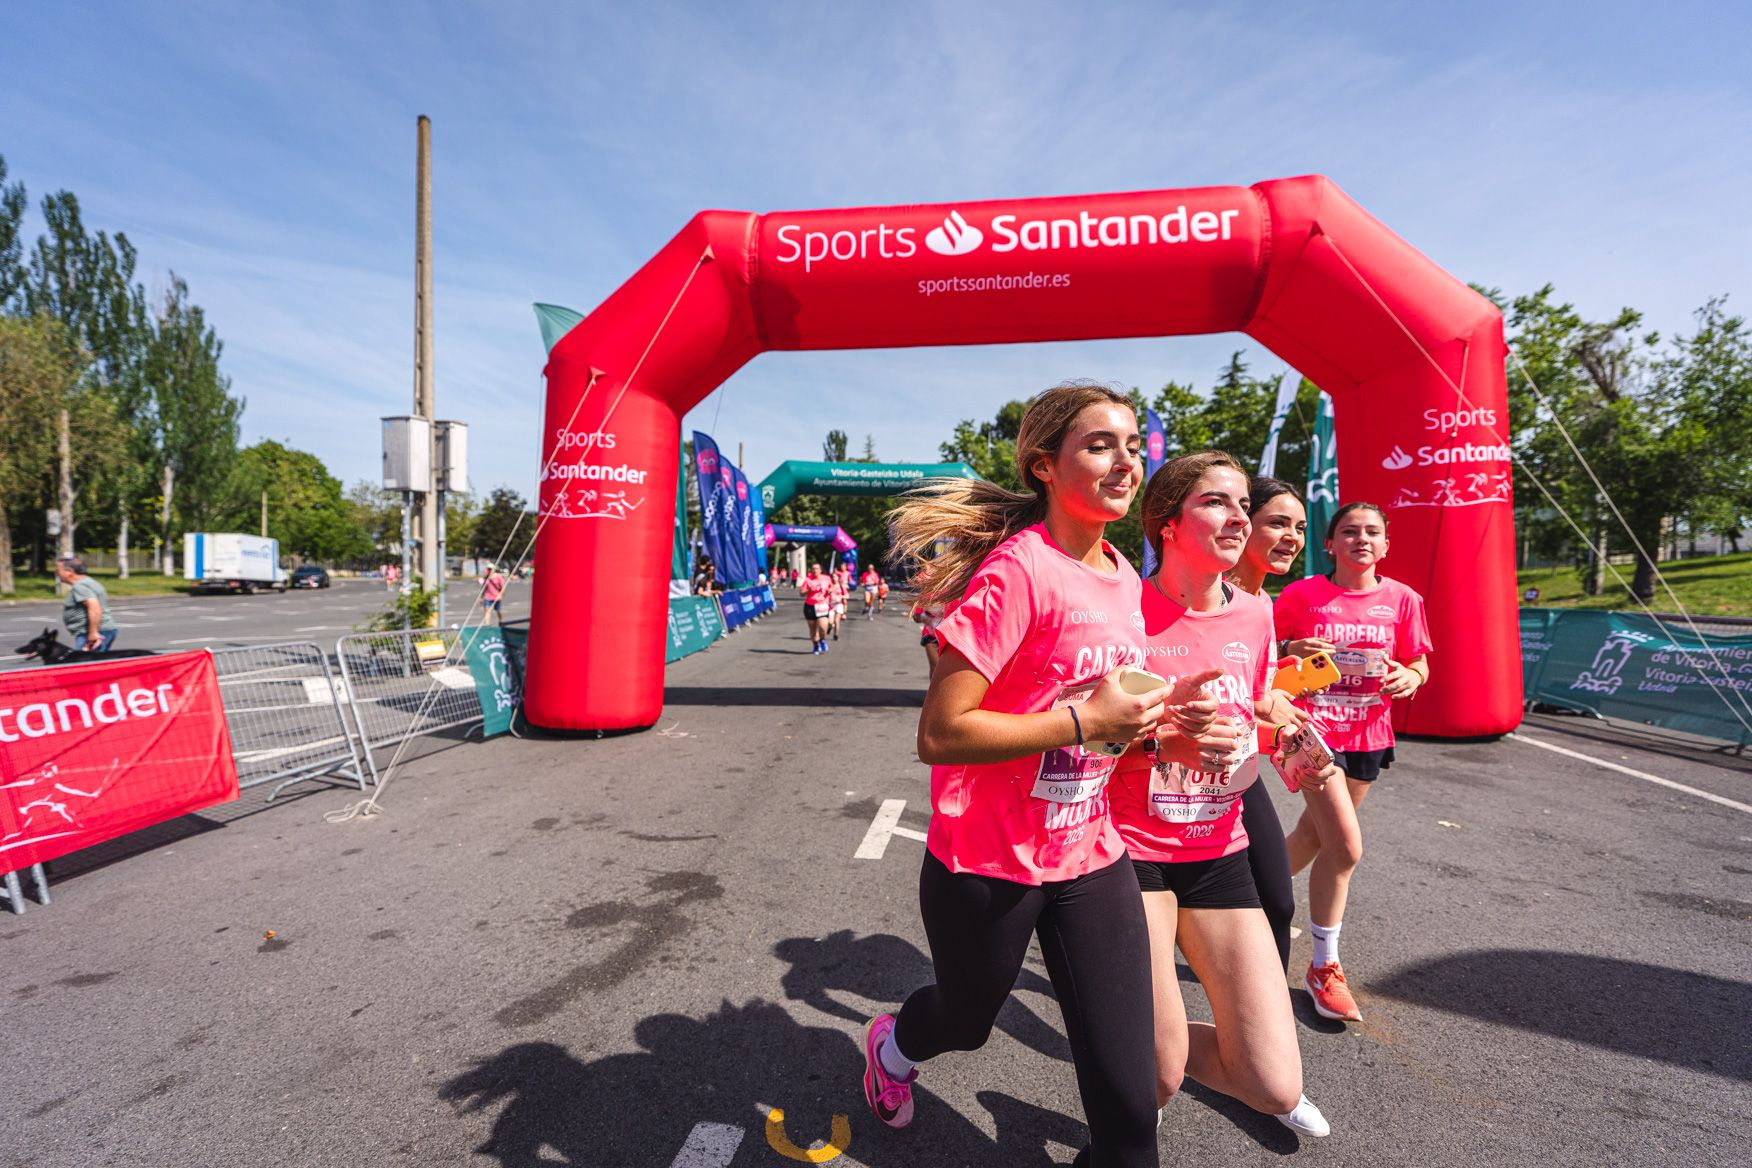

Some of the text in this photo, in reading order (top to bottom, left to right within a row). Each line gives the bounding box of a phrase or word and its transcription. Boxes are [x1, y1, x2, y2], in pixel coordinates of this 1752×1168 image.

[776, 204, 1240, 272] Sports Santander
[917, 271, 1071, 296] sportssantander.es
[1423, 406, 1497, 434] Sports
[556, 428, 617, 451] Sports
[549, 460, 648, 485] Santander
[813, 477, 870, 488] Ayuntamiento
[871, 478, 882, 488] de
[1071, 610, 1108, 625] OYSHO
[1314, 623, 1387, 644] CARRERA
[1650, 651, 1671, 665] de
[1042, 772, 1068, 780] CARRERA
[1068, 772, 1075, 780] DE
[1048, 785, 1084, 796] OYSHO
[1199, 786, 1221, 796] 2041
[1154, 795, 1179, 803] CARRERA
[1162, 807, 1197, 817] OYSHO
